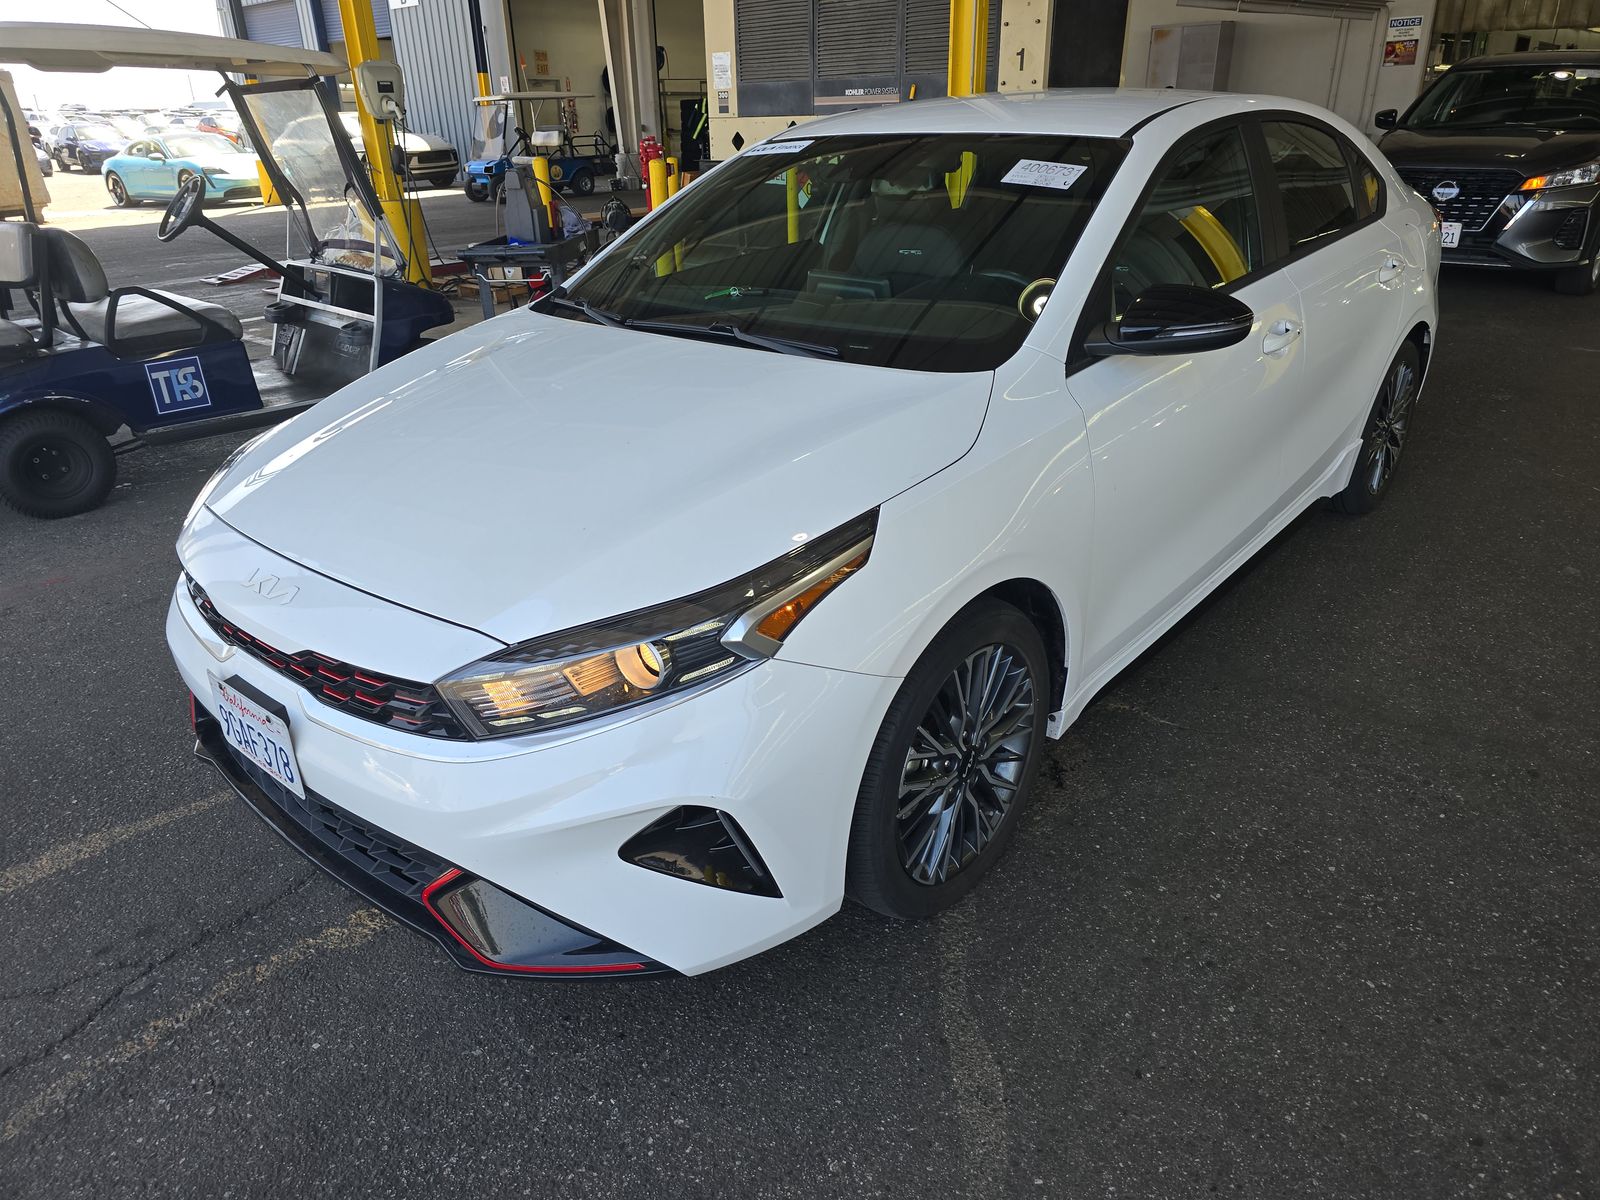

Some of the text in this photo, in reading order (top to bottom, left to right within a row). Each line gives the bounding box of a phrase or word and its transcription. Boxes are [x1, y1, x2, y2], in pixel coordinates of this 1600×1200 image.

[1391, 18, 1421, 27] NOTICE
[1016, 47, 1025, 71] 1
[718, 91, 728, 99] 300
[150, 366, 204, 404] TRS
[221, 686, 268, 726] California
[219, 704, 295, 784] 9GAF378
